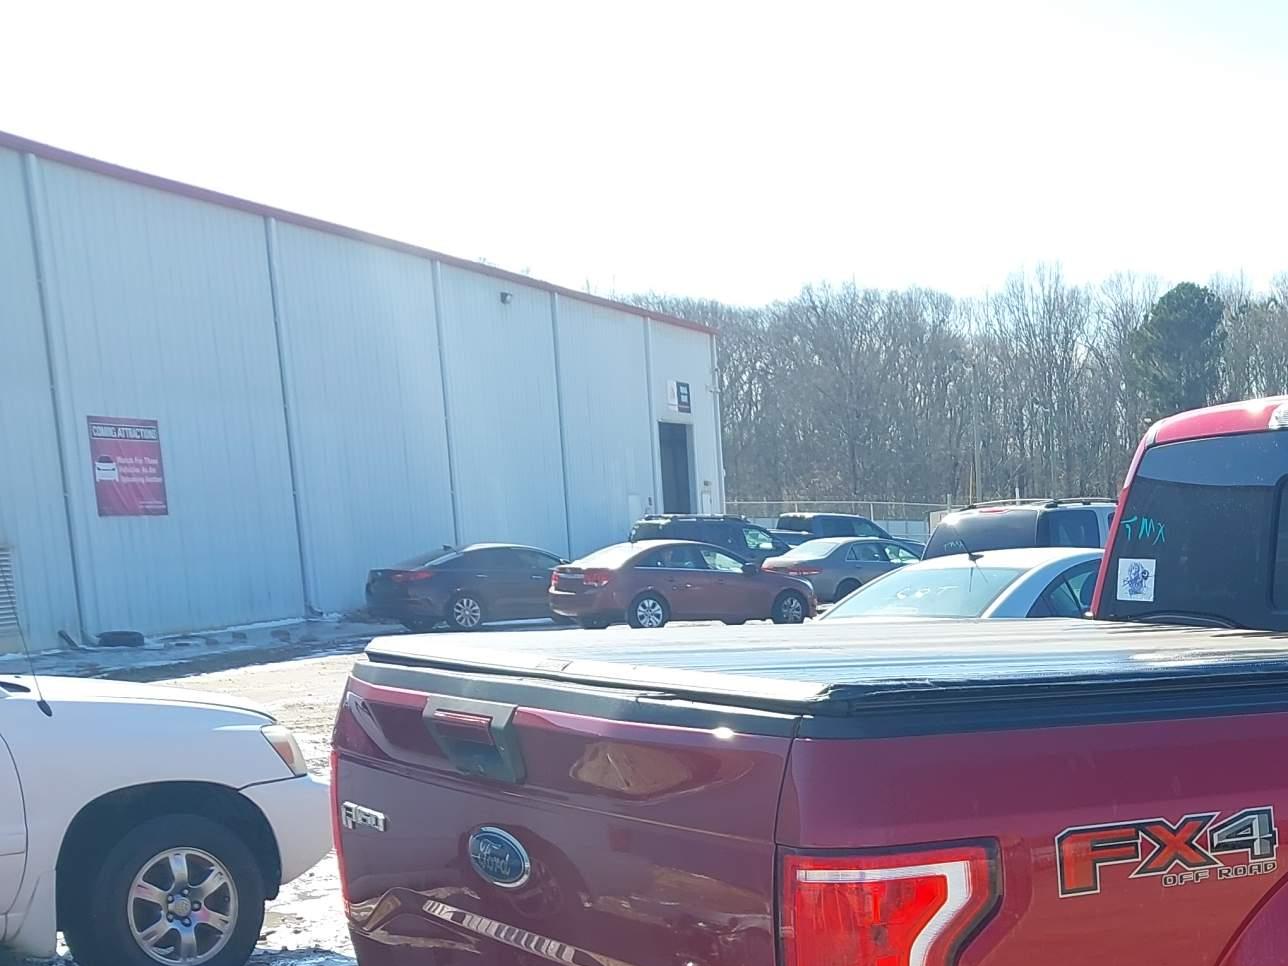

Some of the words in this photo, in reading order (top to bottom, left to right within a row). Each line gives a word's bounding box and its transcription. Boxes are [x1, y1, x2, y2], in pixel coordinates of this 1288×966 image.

[92, 426, 117, 437] COG
[118, 427, 157, 439] ATTACTS
[474, 838, 512, 877] Ford
[1055, 806, 1278, 897] FX4
[1162, 869, 1210, 888] OFF
[1217, 860, 1278, 881] ROAD
